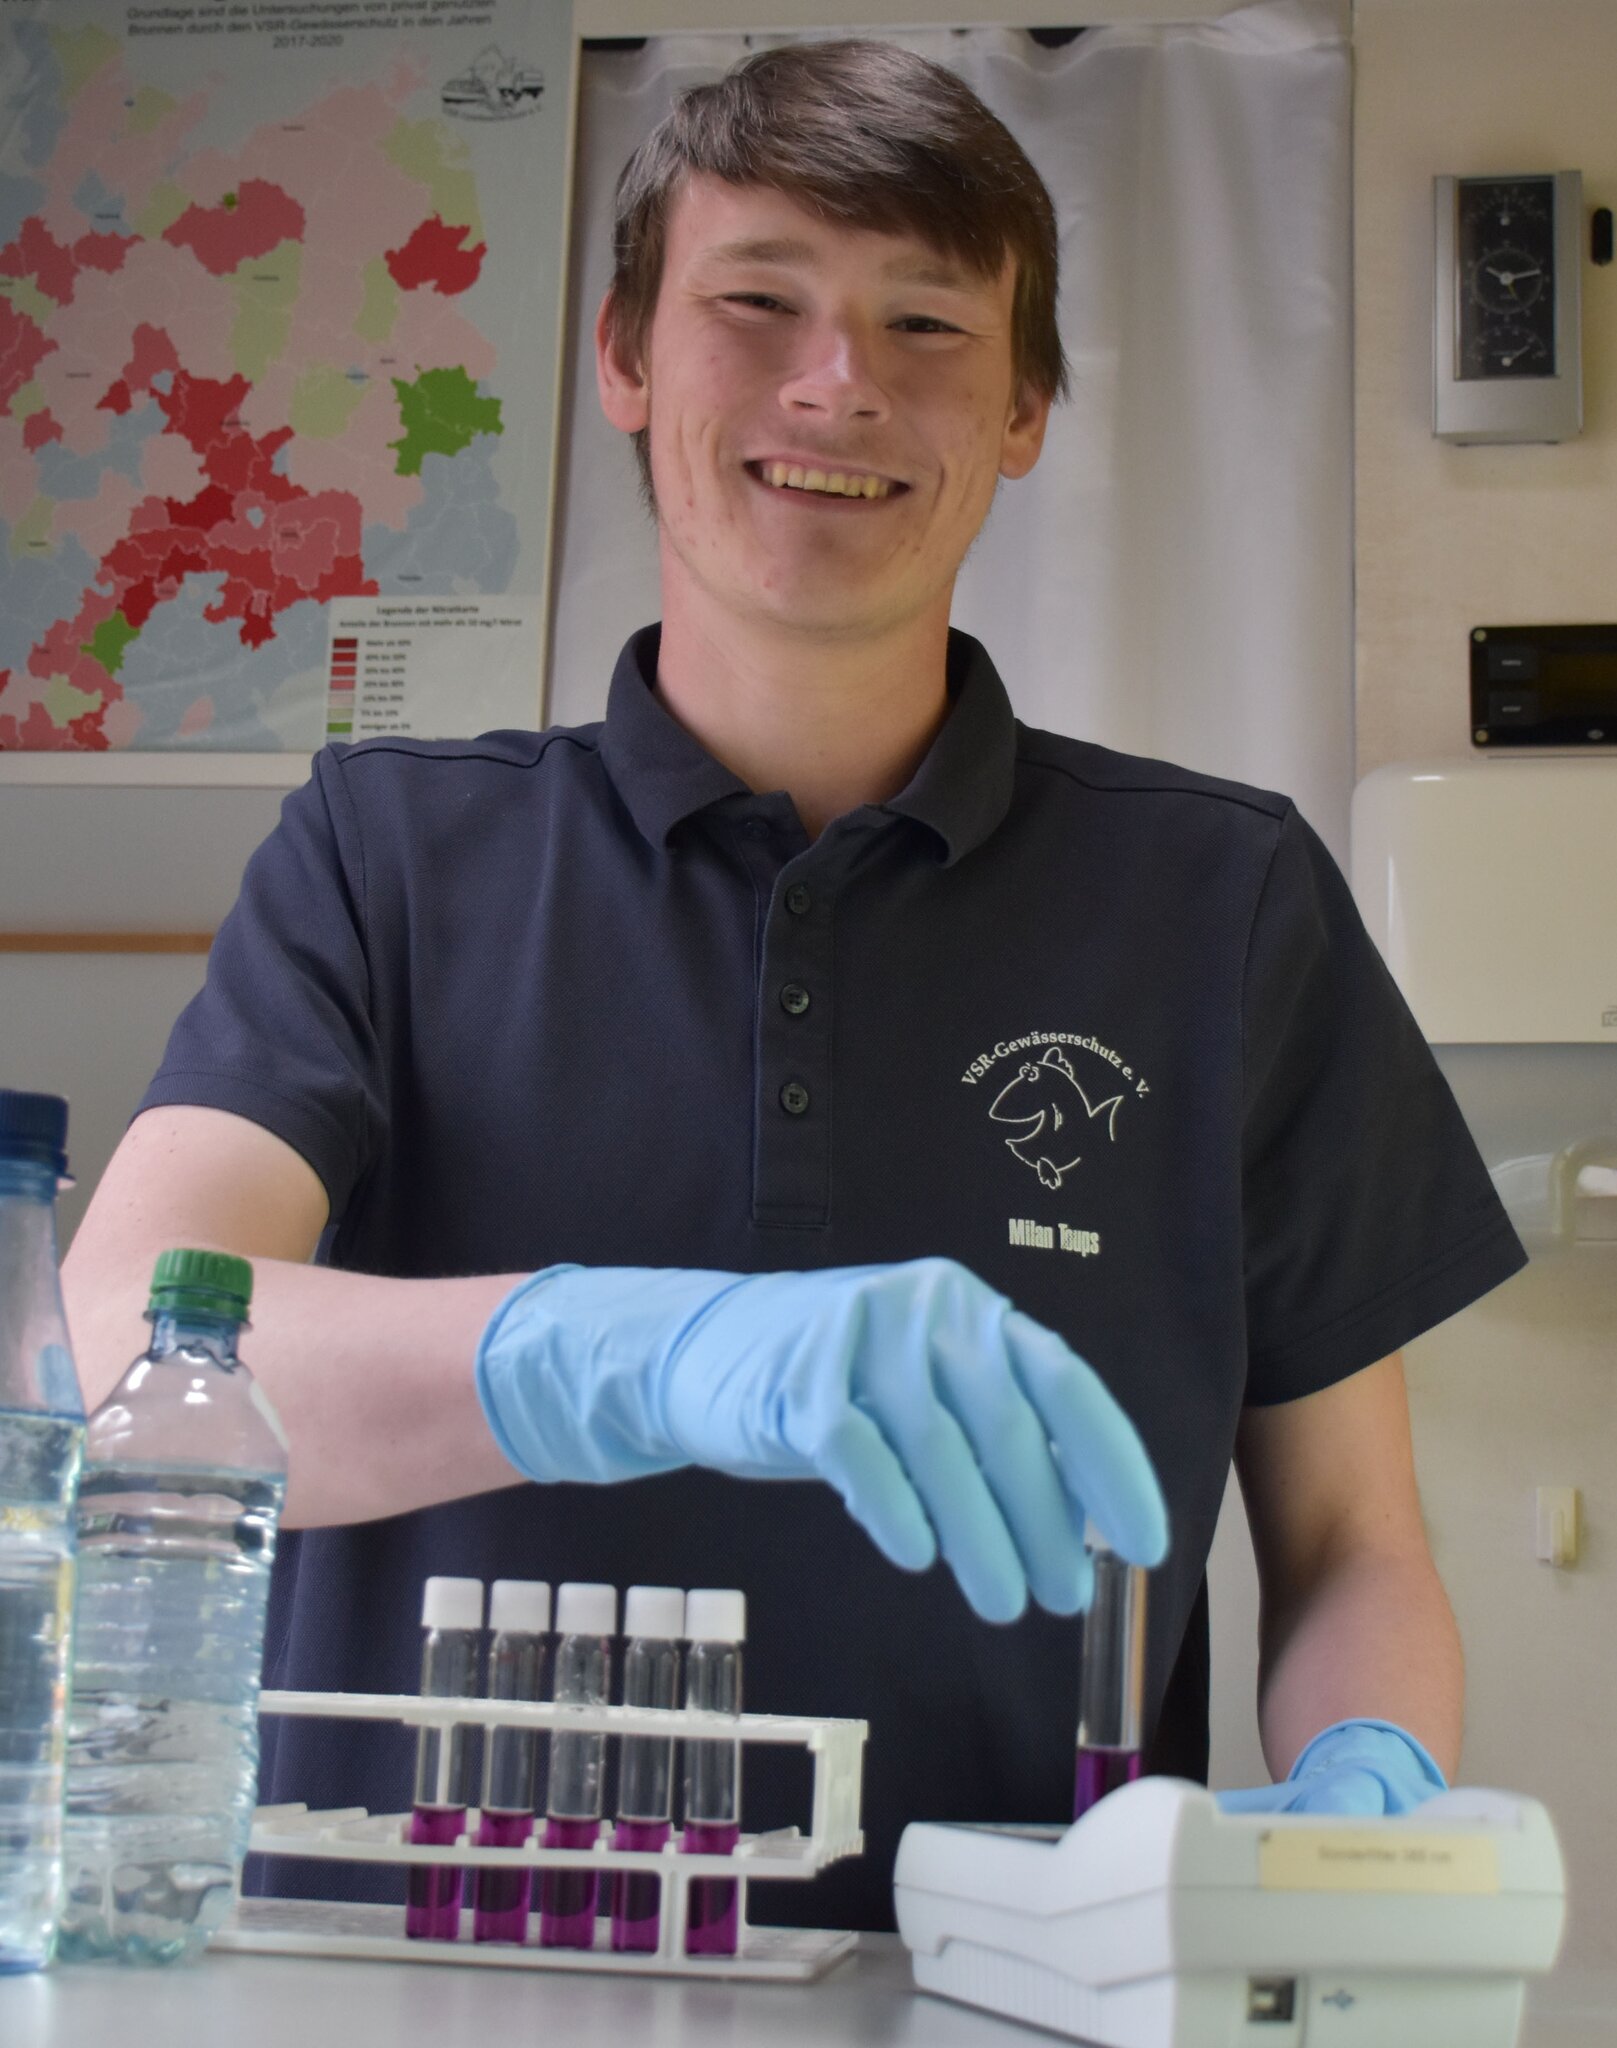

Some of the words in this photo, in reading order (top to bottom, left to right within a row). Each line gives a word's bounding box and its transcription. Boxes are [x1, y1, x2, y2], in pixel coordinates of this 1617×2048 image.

[127, 7, 194, 19] Grundlage
[198, 6, 225, 17] sind
[229, 5, 249, 16] die
[252, 2, 359, 15] Untersuchungen
[128, 24, 184, 36] Brunnen
[187, 23, 224, 34] durch
[227, 22, 252, 33] den
[418, 16, 443, 26] den
[447, 14, 492, 26] Jahren
[272, 35, 344, 48] 2017-2020
[961, 1031, 1123, 1087] VSR-Gewässerschutz
[1121, 1065, 1133, 1081] e.
[1135, 1078, 1150, 1098] V.
[1008, 1217, 1054, 1249] Milan
